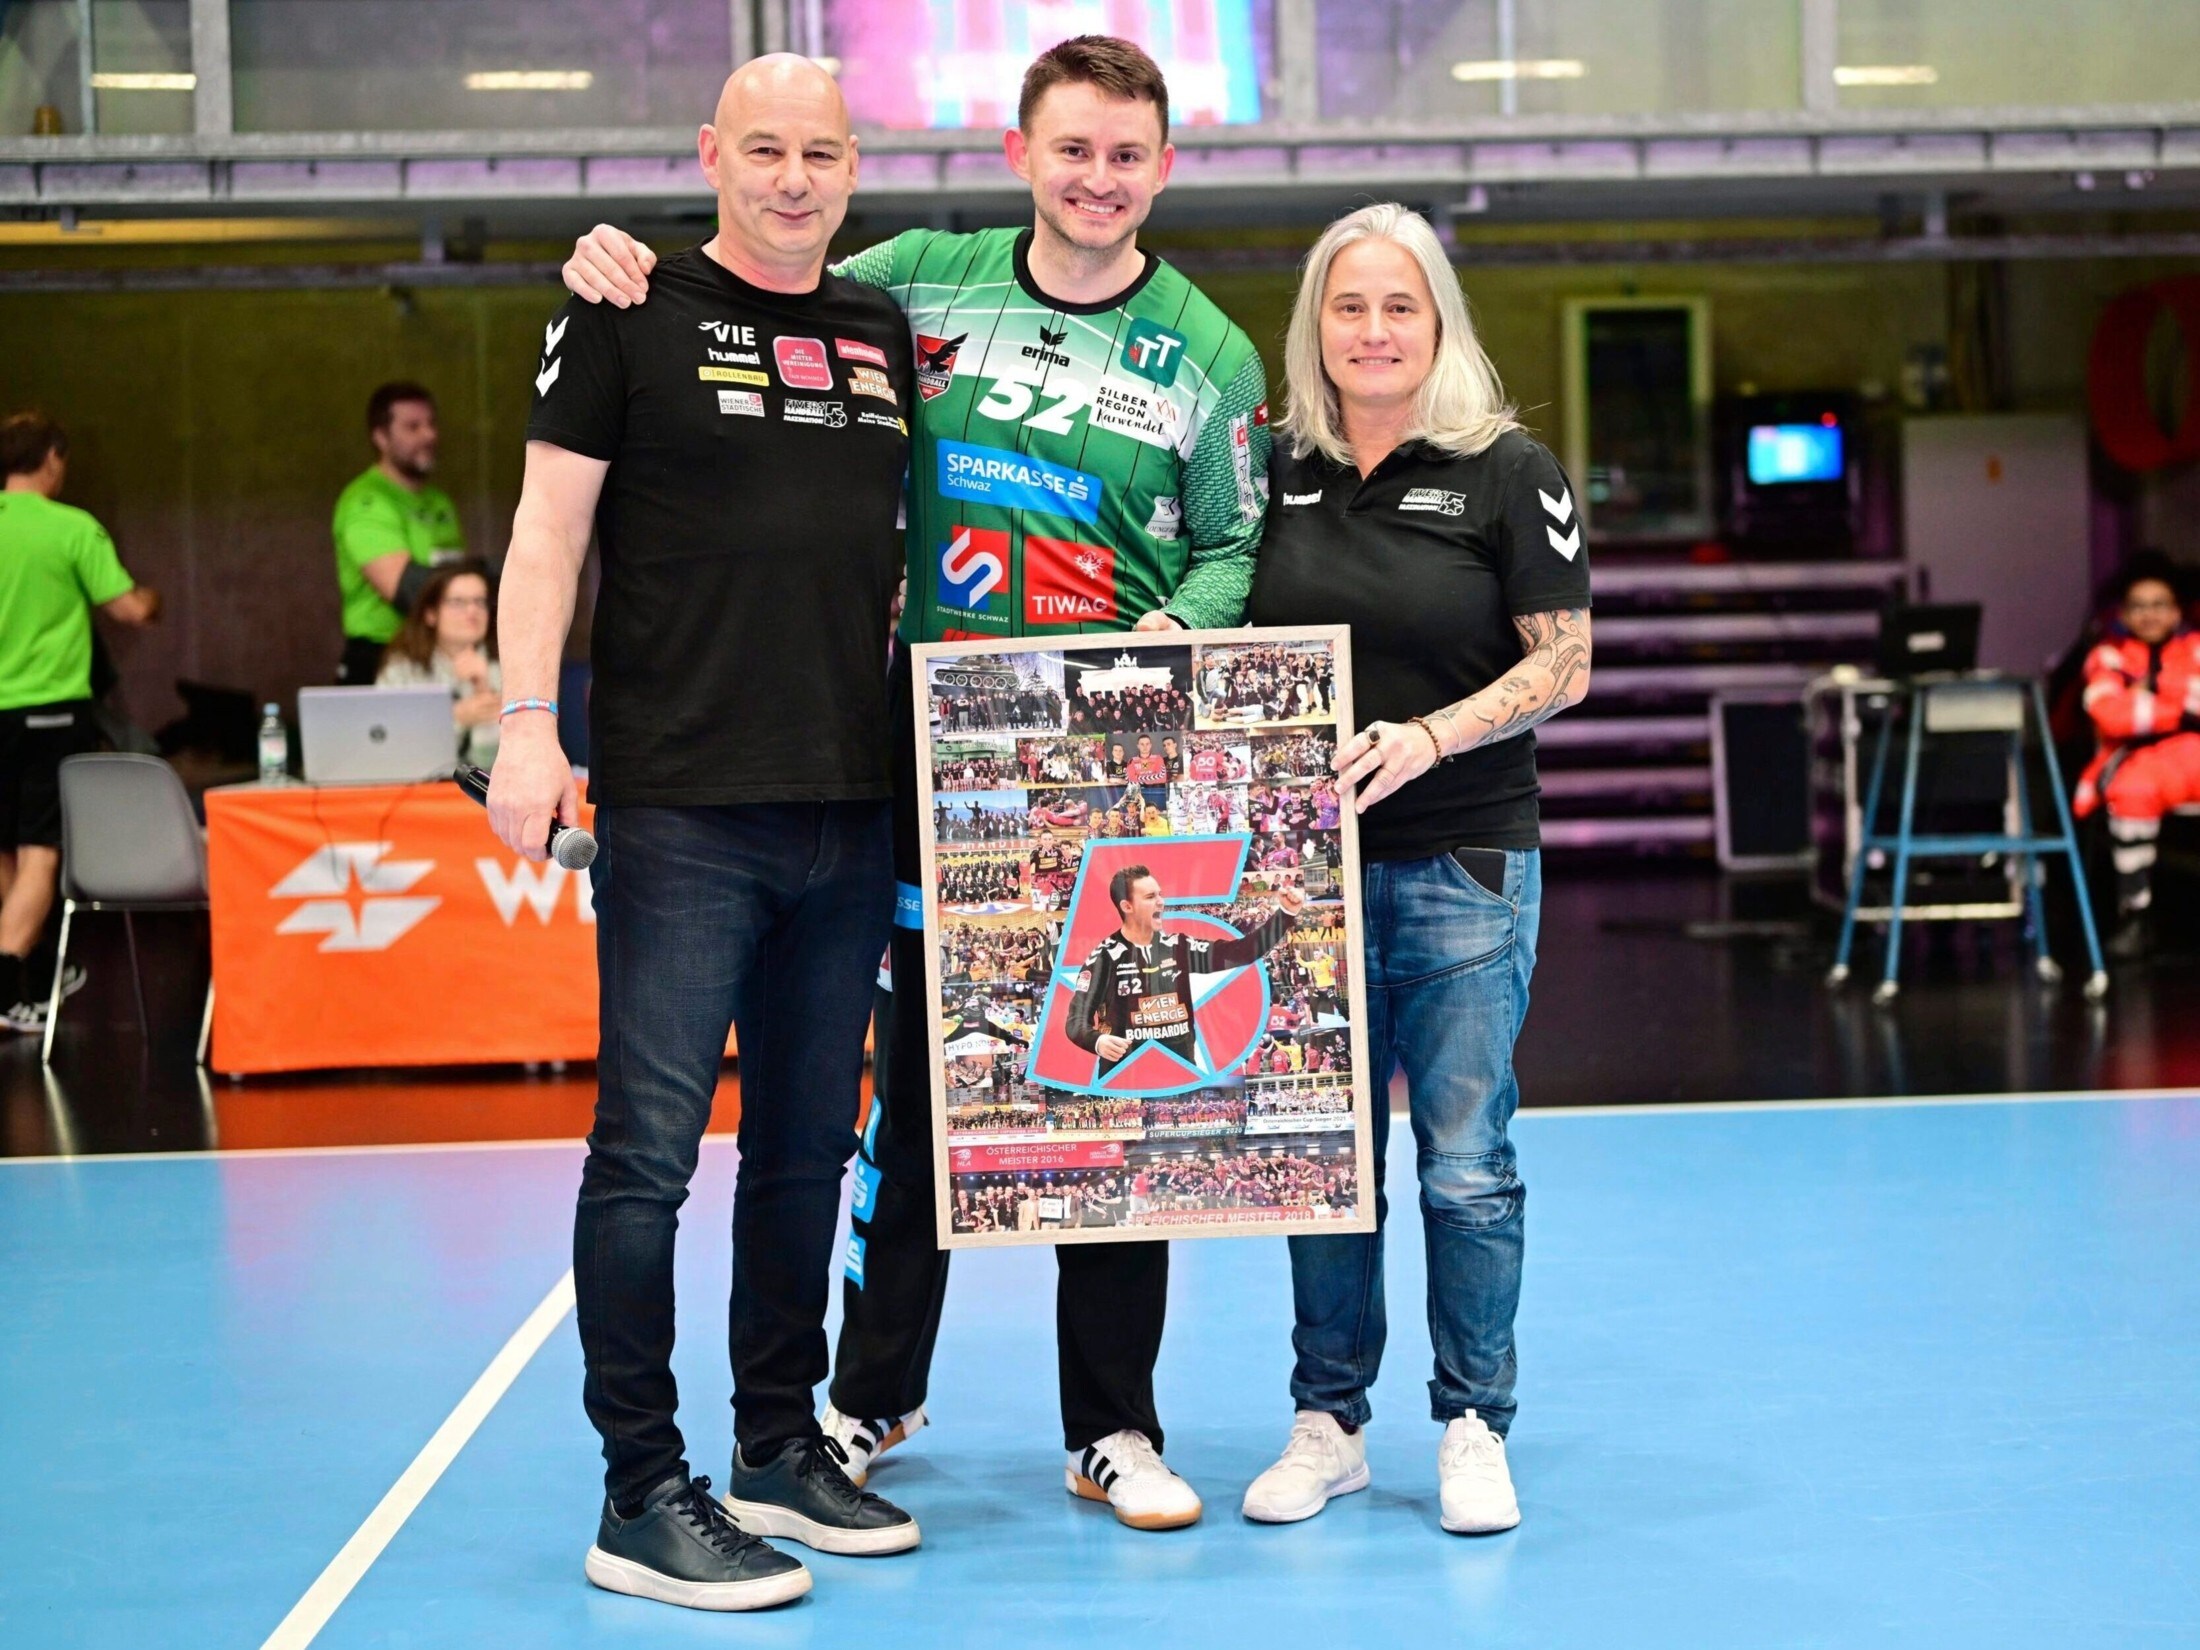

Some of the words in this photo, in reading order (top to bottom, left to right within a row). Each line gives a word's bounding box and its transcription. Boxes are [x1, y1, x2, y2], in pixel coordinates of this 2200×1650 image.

[714, 324, 756, 346] VIE
[707, 347, 761, 365] hummel
[1021, 344, 1070, 367] erima
[1135, 333, 1182, 369] TT
[860, 370, 888, 384] WIEN
[852, 381, 896, 400] ENERGIE
[977, 364, 1089, 436] 52
[1099, 386, 1148, 408] SILBER
[1096, 396, 1146, 419] REGION
[1096, 408, 1168, 436] Karwendel
[947, 453, 1065, 495] SPARKASSE
[947, 474, 991, 493] Schwaz
[936, 605, 976, 619] STADTWERKE
[978, 613, 1009, 623] SCHWAZ
[1032, 595, 1108, 615] TIWAG
[1118, 977, 1143, 996] 52
[1142, 996, 1178, 1011] WIEN
[1149, 1128, 1221, 1138] SUPERCUPSIEGER
[986, 1143, 1077, 1157] ÖSTERREICHISCHER
[999, 1156, 1039, 1166] MEISTER
[1041, 1155, 1064, 1164] 2016
[1227, 1212, 1281, 1223] MEISTER
[1285, 1211, 1311, 1221] 2018
